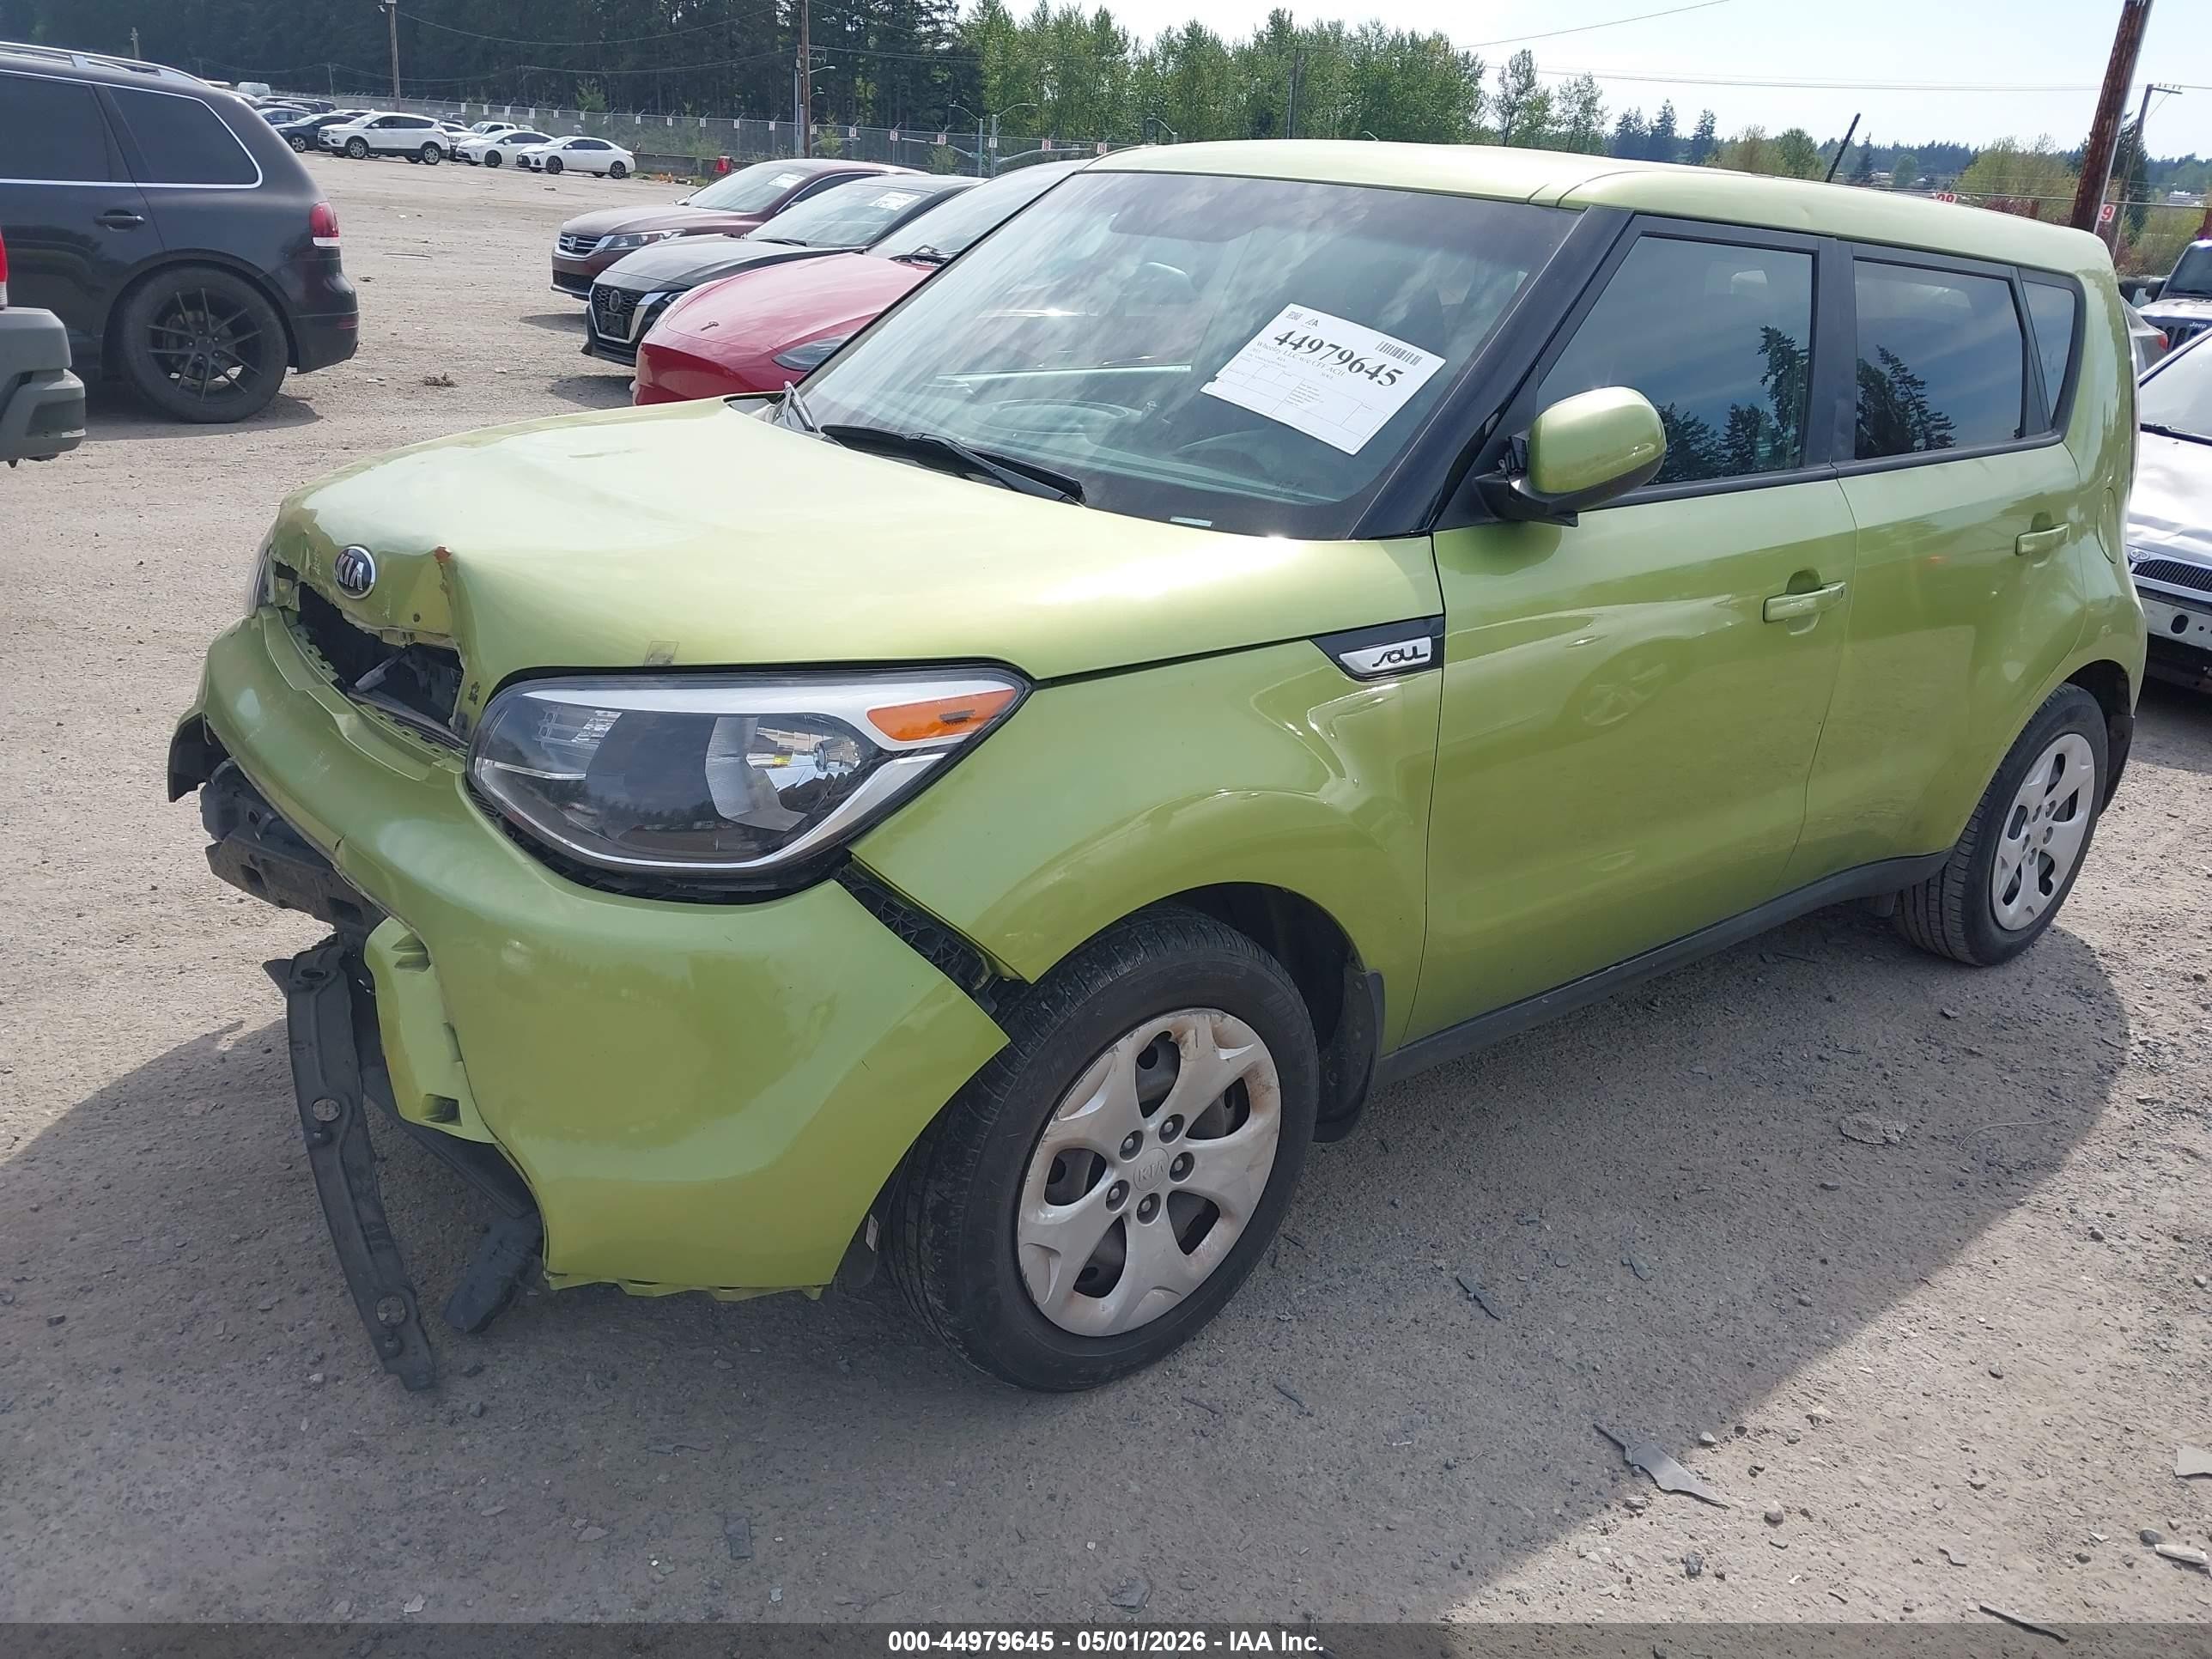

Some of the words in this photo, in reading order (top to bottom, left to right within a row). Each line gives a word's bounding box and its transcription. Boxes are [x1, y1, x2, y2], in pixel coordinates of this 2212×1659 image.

[1273, 330, 1405, 387] 44979645
[335, 553, 365, 591] KIA
[1139, 1161, 1165, 1182] KIA
